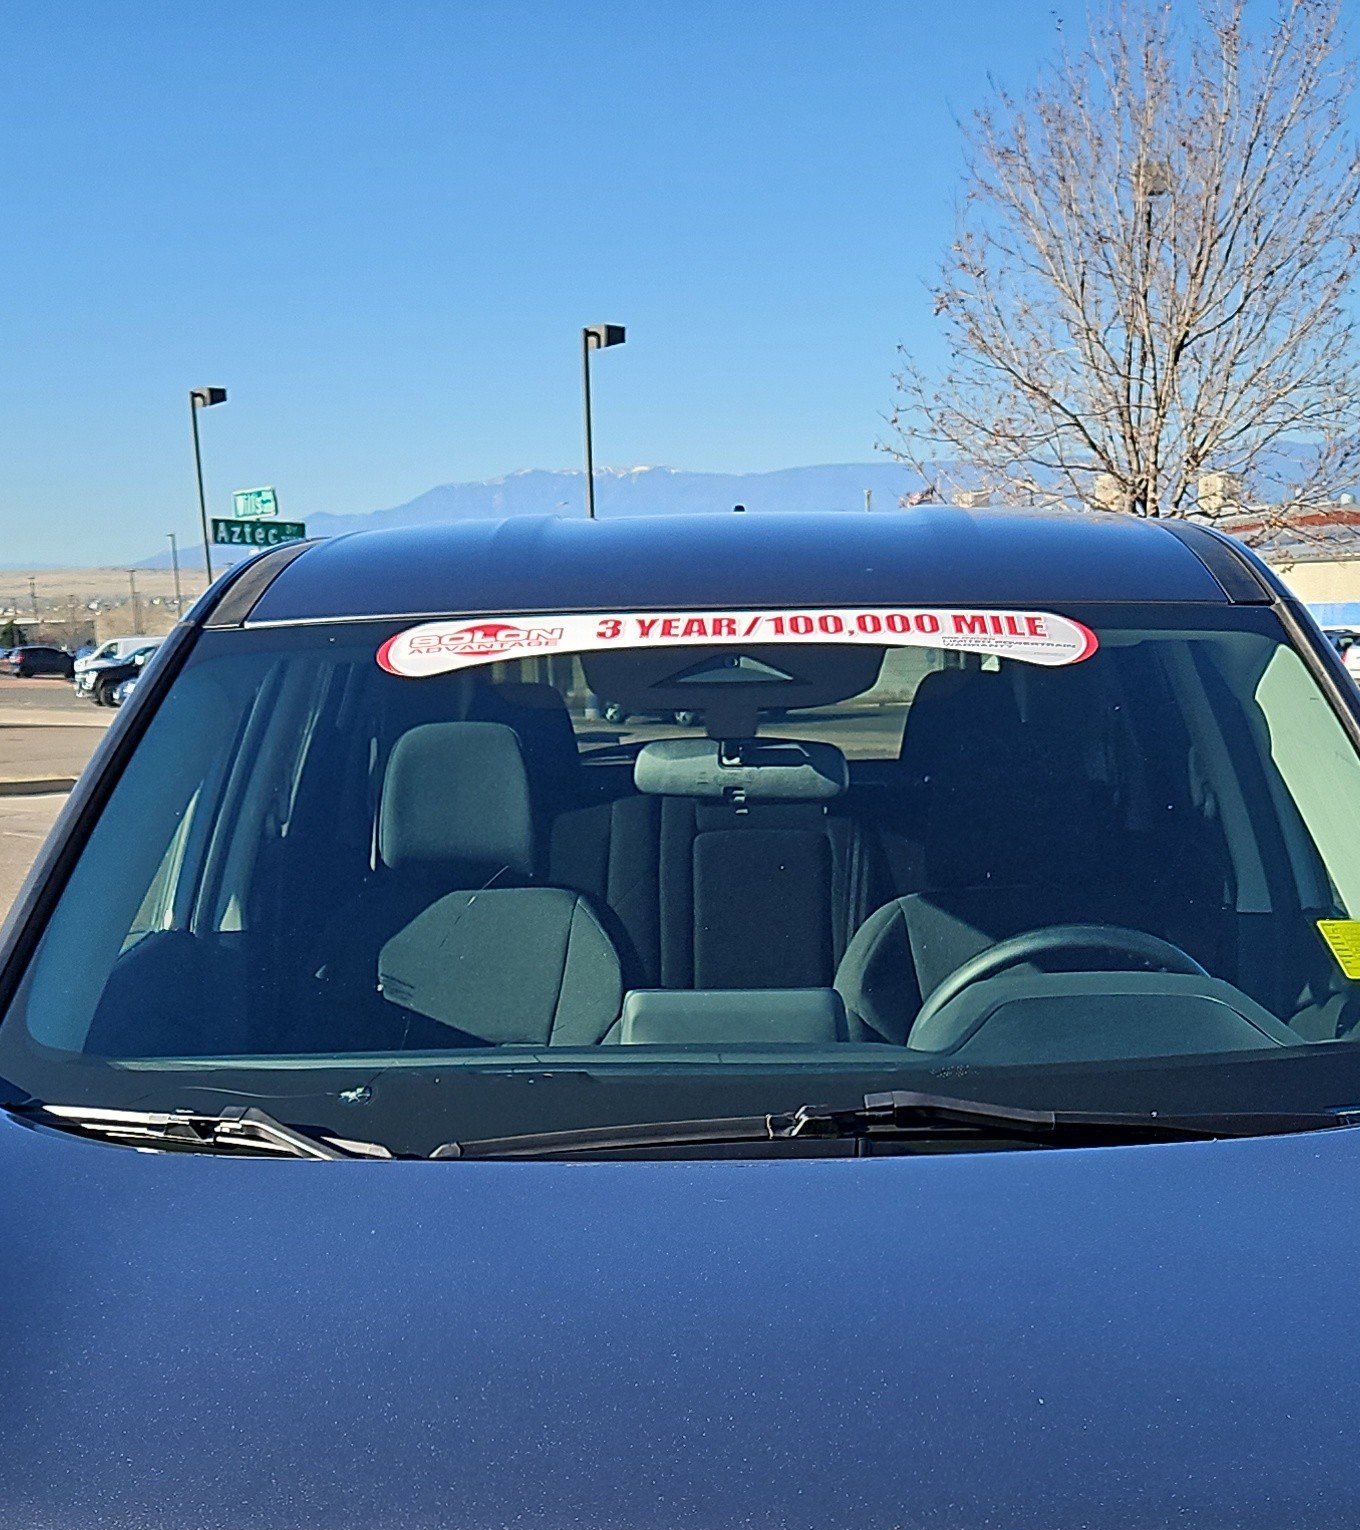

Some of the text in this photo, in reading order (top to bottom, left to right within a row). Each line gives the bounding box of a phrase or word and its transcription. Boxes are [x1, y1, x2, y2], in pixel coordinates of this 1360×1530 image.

[217, 522, 278, 544] Aztec
[597, 613, 1047, 638] 3 YEAR/100,000 MILE
[409, 637, 558, 655] ADVANTAGE
[410, 628, 563, 649] SOLON
